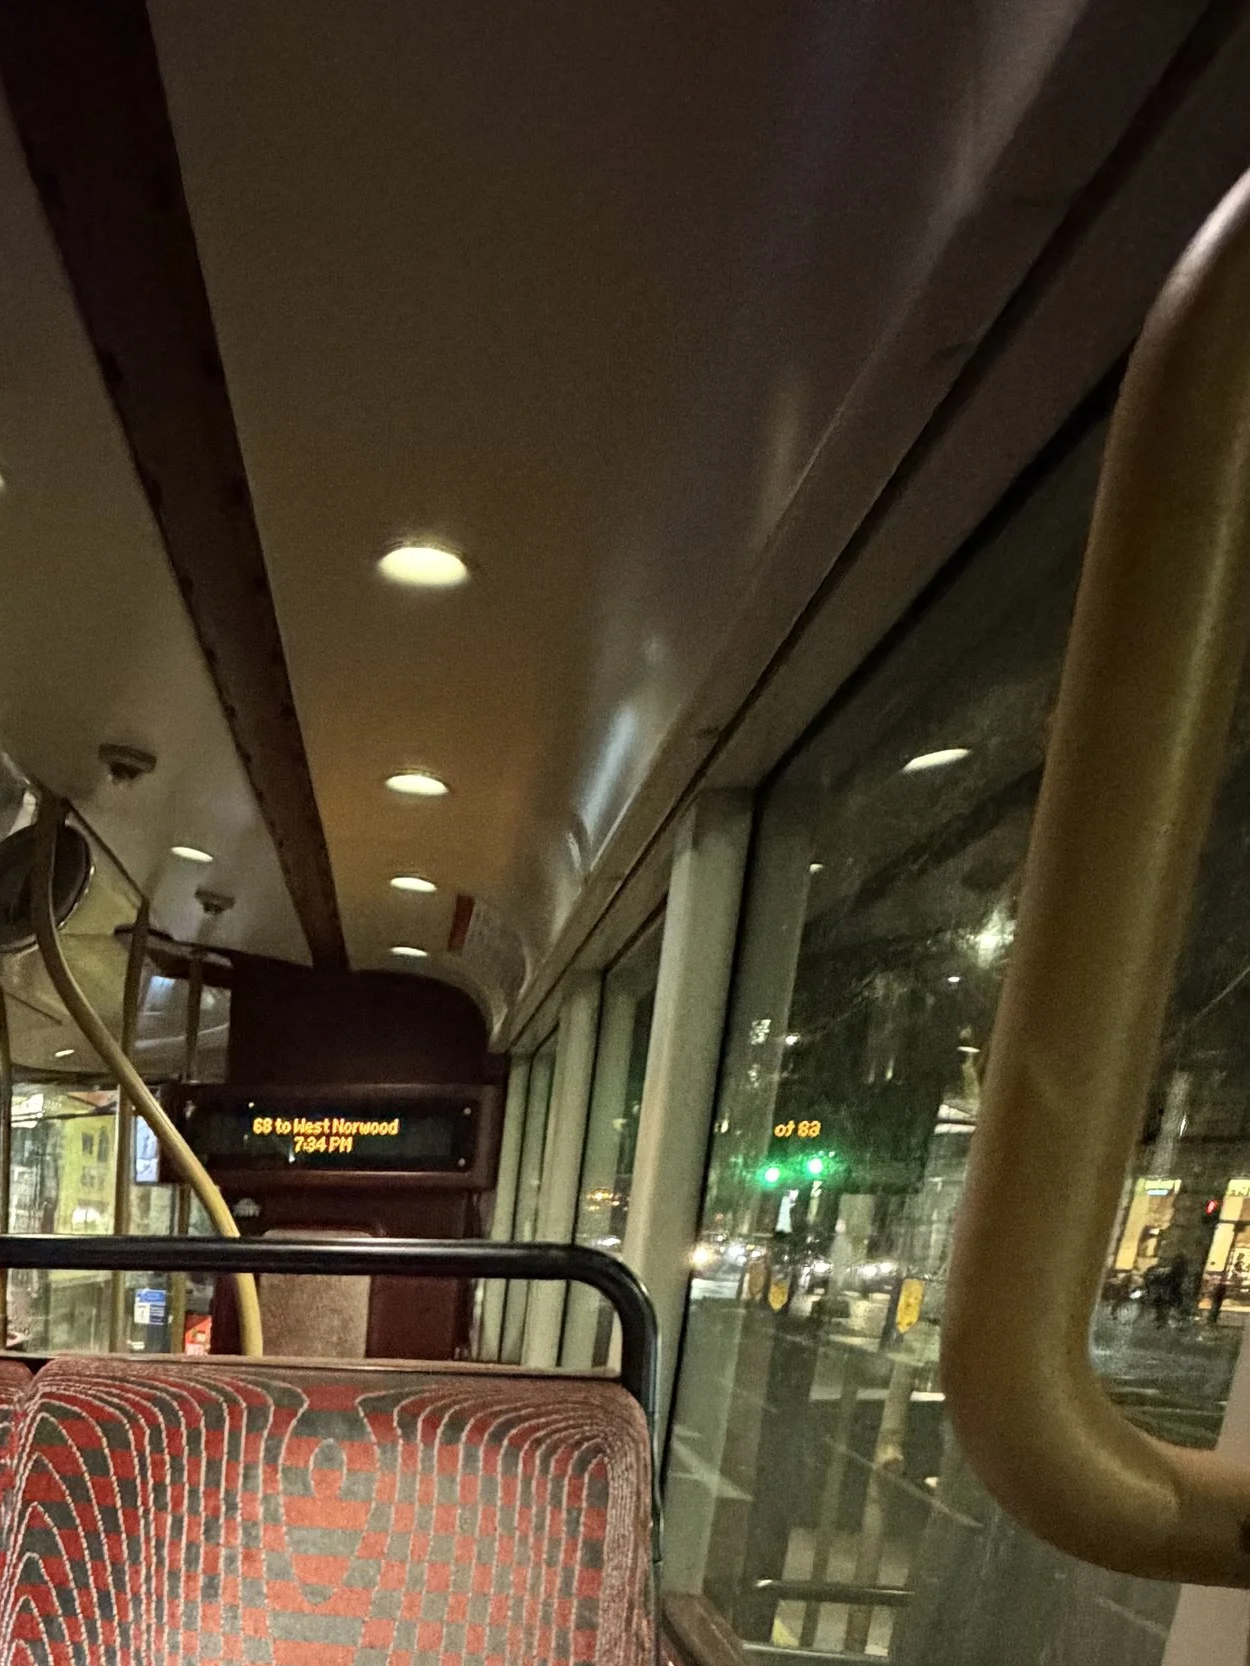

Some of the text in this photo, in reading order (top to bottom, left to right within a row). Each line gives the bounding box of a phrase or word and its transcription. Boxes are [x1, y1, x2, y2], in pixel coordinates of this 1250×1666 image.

[252, 1117, 399, 1136] 68 to West Norwood
[329, 1136, 354, 1153] PM
